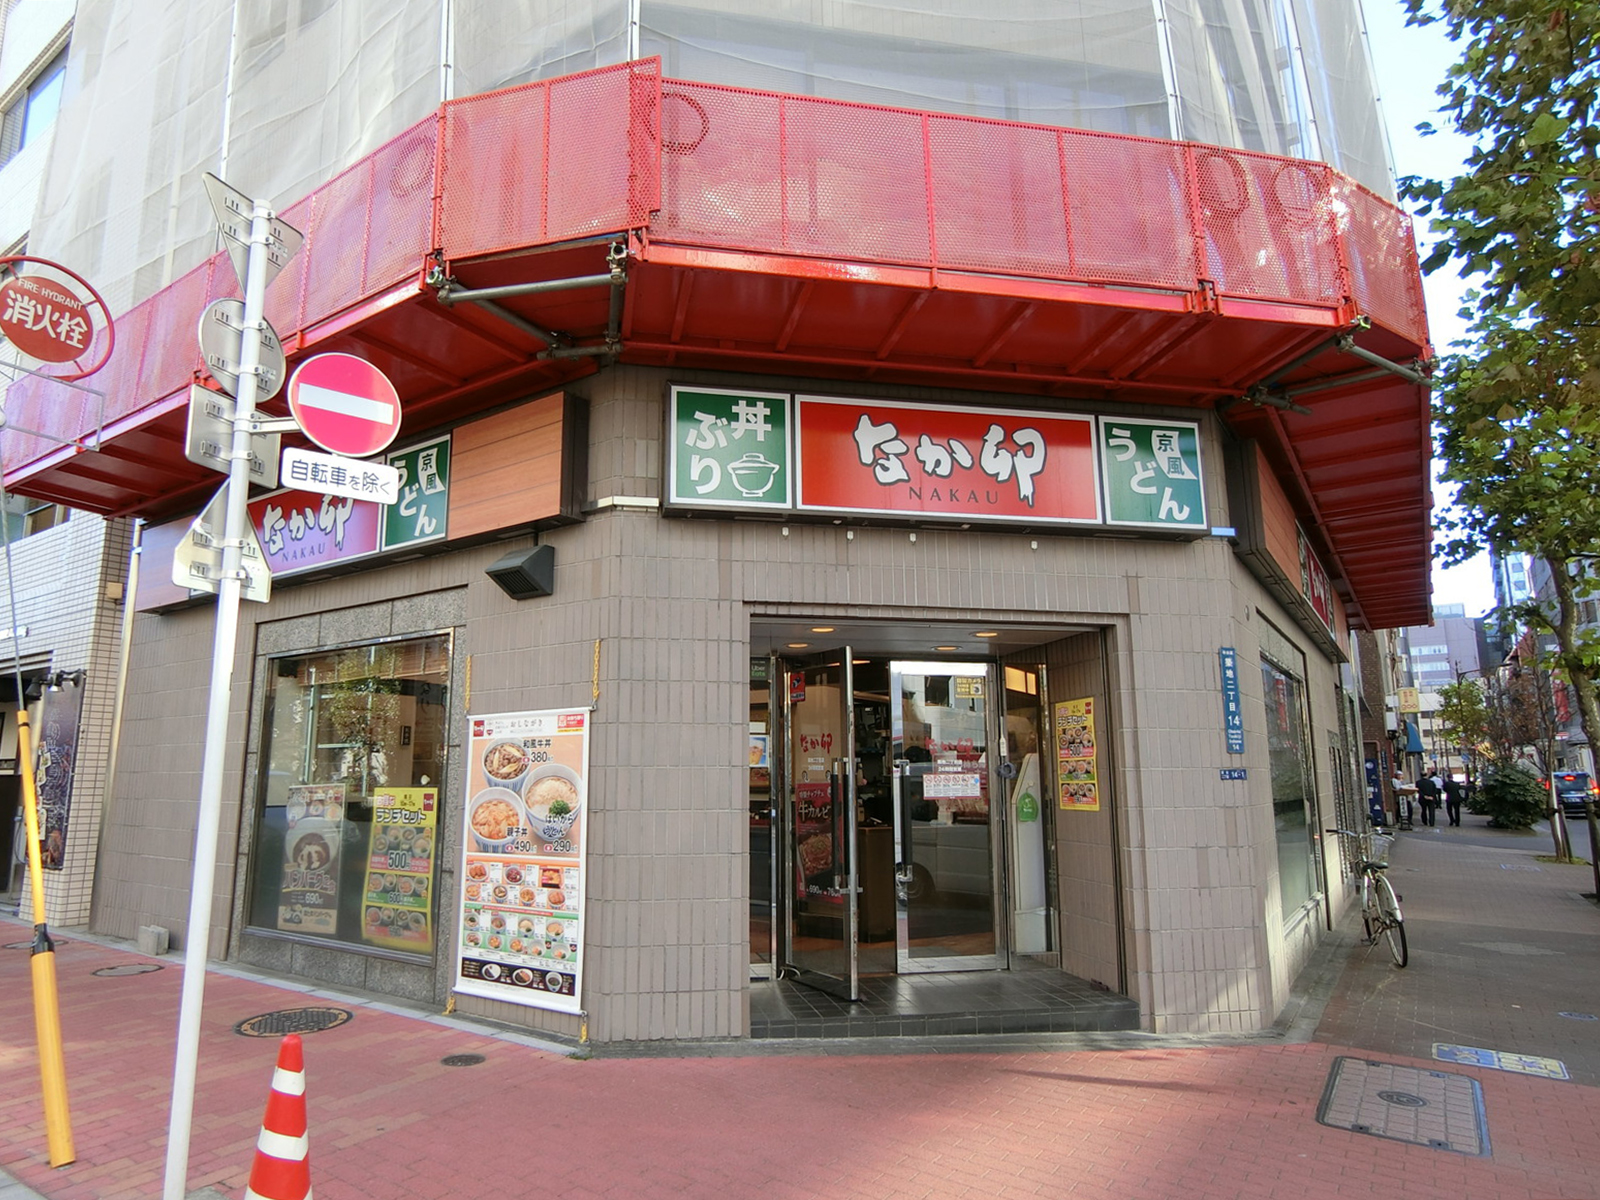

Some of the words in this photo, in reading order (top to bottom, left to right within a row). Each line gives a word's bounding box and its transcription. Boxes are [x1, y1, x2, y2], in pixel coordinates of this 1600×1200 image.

[18, 278, 40, 294] FIRE
[41, 287, 83, 311] HYDRANT
[2, 289, 89, 349] 消火栓
[1156, 431, 1186, 477] 京風
[290, 458, 392, 496] 自転車を除く
[420, 452, 437, 492] 京風
[1108, 426, 1190, 522] うどん
[907, 486, 999, 505] NAKAU
[282, 542, 327, 563] NAKAU
[1228, 714, 1241, 726] 14
[531, 751, 548, 763] 380
[376, 808, 427, 825] ランチセット
[514, 840, 531, 852] 490
[553, 840, 571, 852] 290
[388, 851, 408, 869] 500
